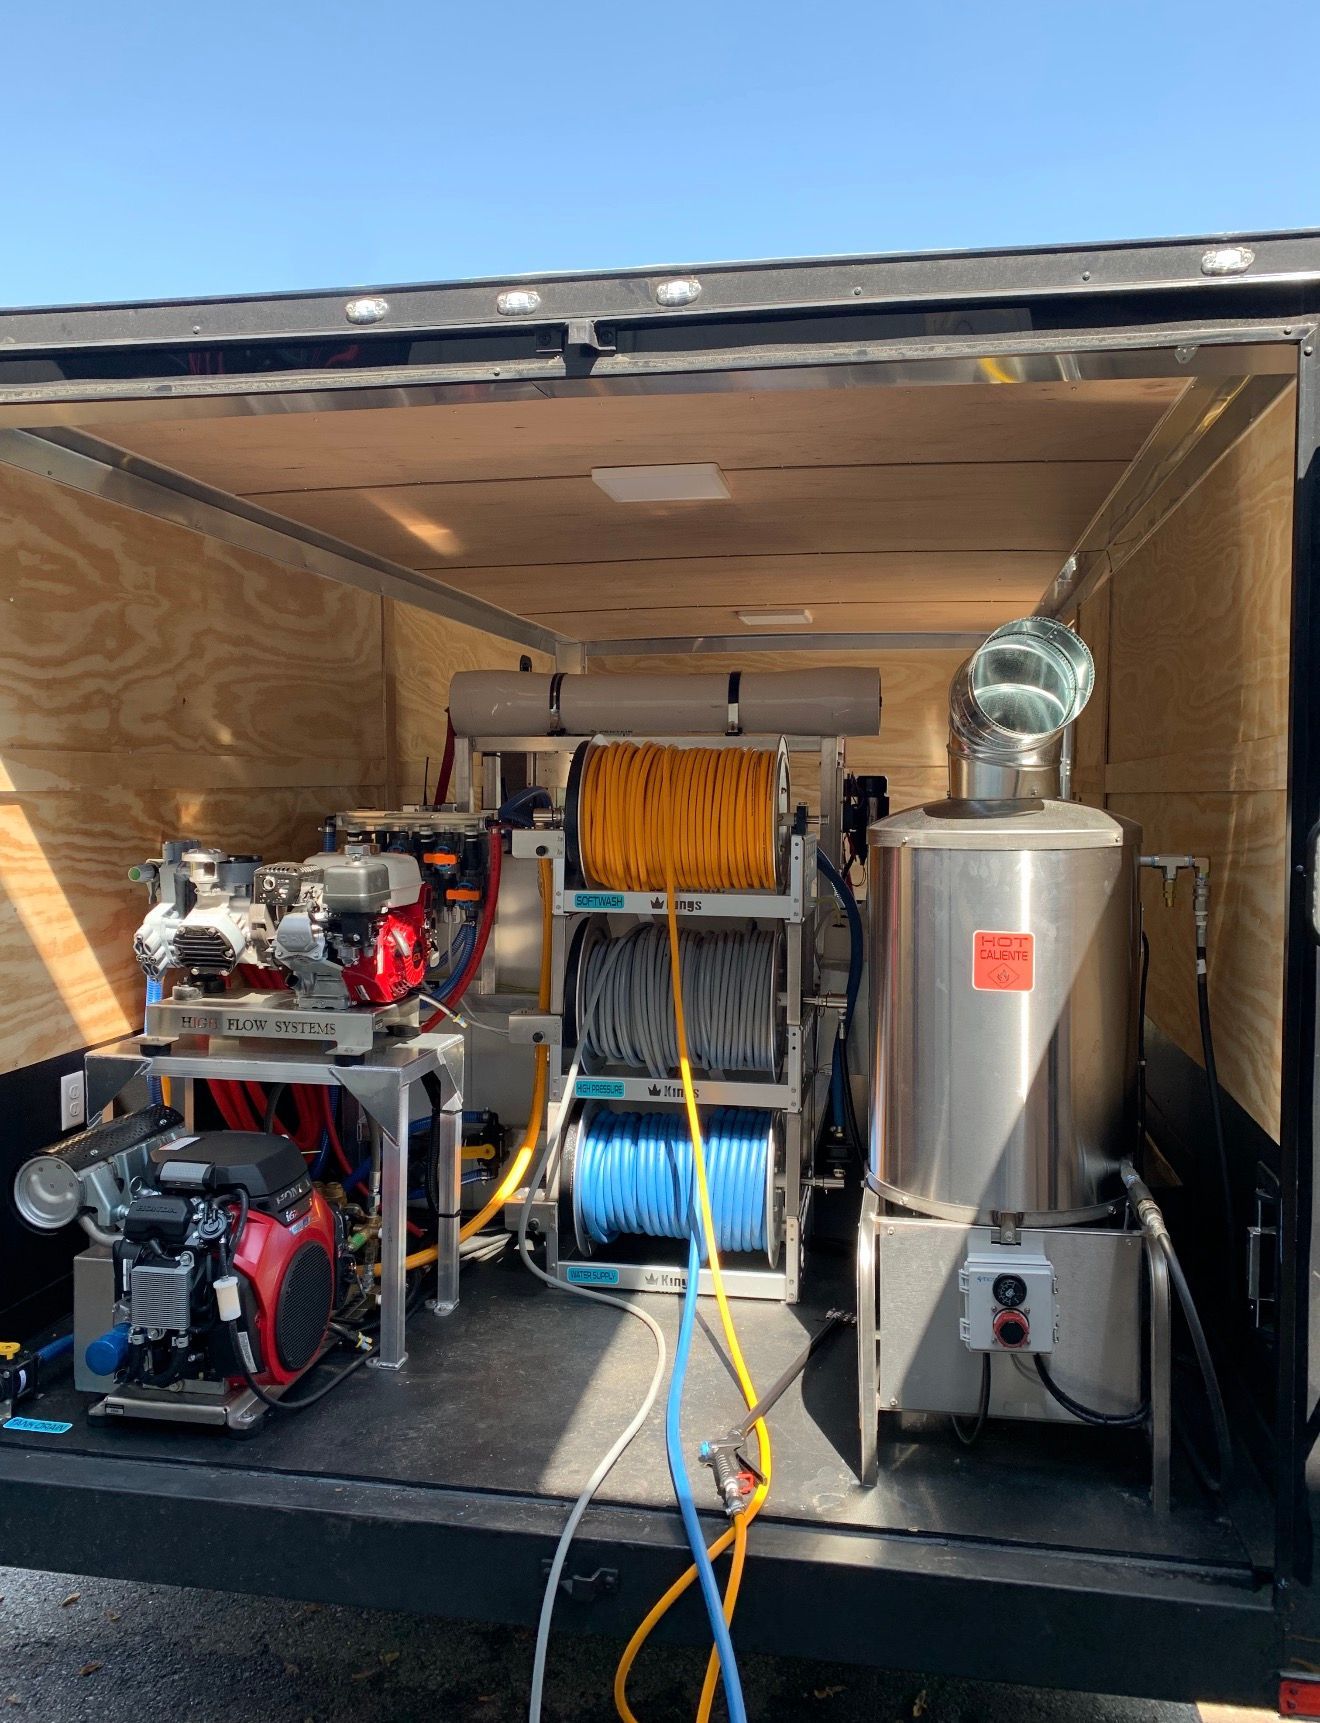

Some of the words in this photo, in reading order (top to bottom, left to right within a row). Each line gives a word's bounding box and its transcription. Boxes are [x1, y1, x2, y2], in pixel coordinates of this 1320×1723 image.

[576, 895, 623, 907] SOFTWASH
[666, 899, 702, 912] ings
[981, 935, 1029, 948] HOT
[980, 949, 1029, 962] CALIENTE
[180, 1016, 218, 1030] HIGH
[227, 1018, 267, 1032] FLOW
[275, 1020, 337, 1035] SYSTEMS
[576, 1084, 591, 1094] HIGH
[592, 1084, 623, 1095] PRESSURE
[663, 1085, 700, 1098] Kins
[571, 1269, 591, 1279] WATER
[592, 1270, 617, 1281] SUPPLY
[661, 1274, 689, 1290] King
